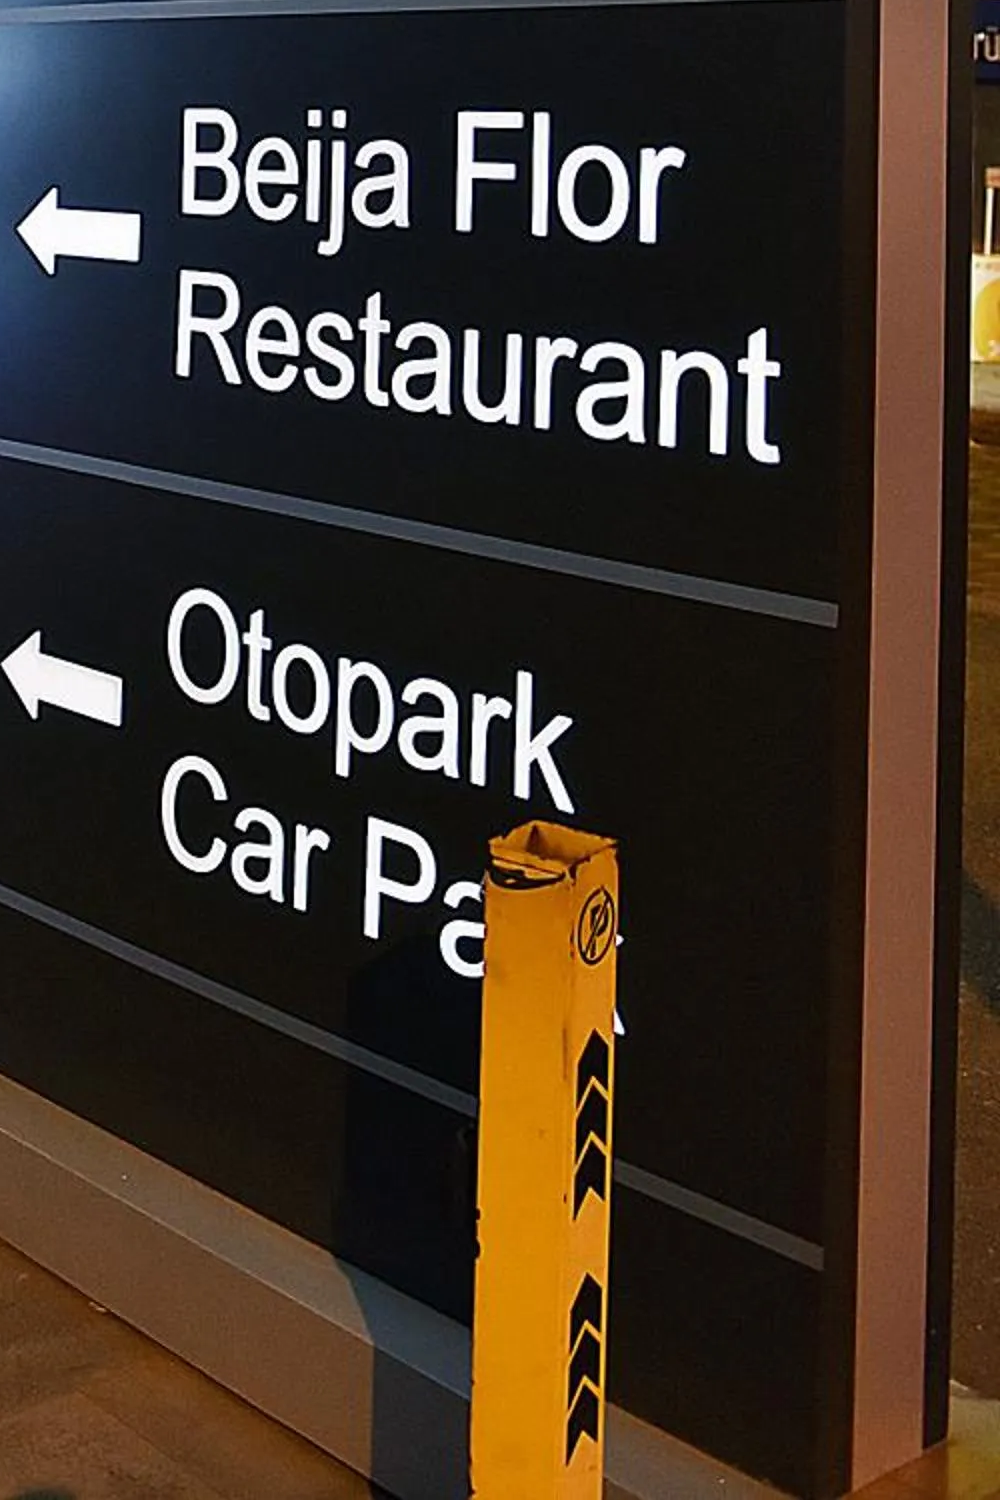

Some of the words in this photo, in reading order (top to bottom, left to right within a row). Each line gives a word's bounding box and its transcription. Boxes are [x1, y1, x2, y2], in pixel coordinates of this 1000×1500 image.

[181, 107, 411, 257] Beija
[455, 111, 687, 244] Flor
[175, 269, 782, 465] Restaurant
[167, 587, 576, 815] Otopark
[161, 755, 332, 912] Car
